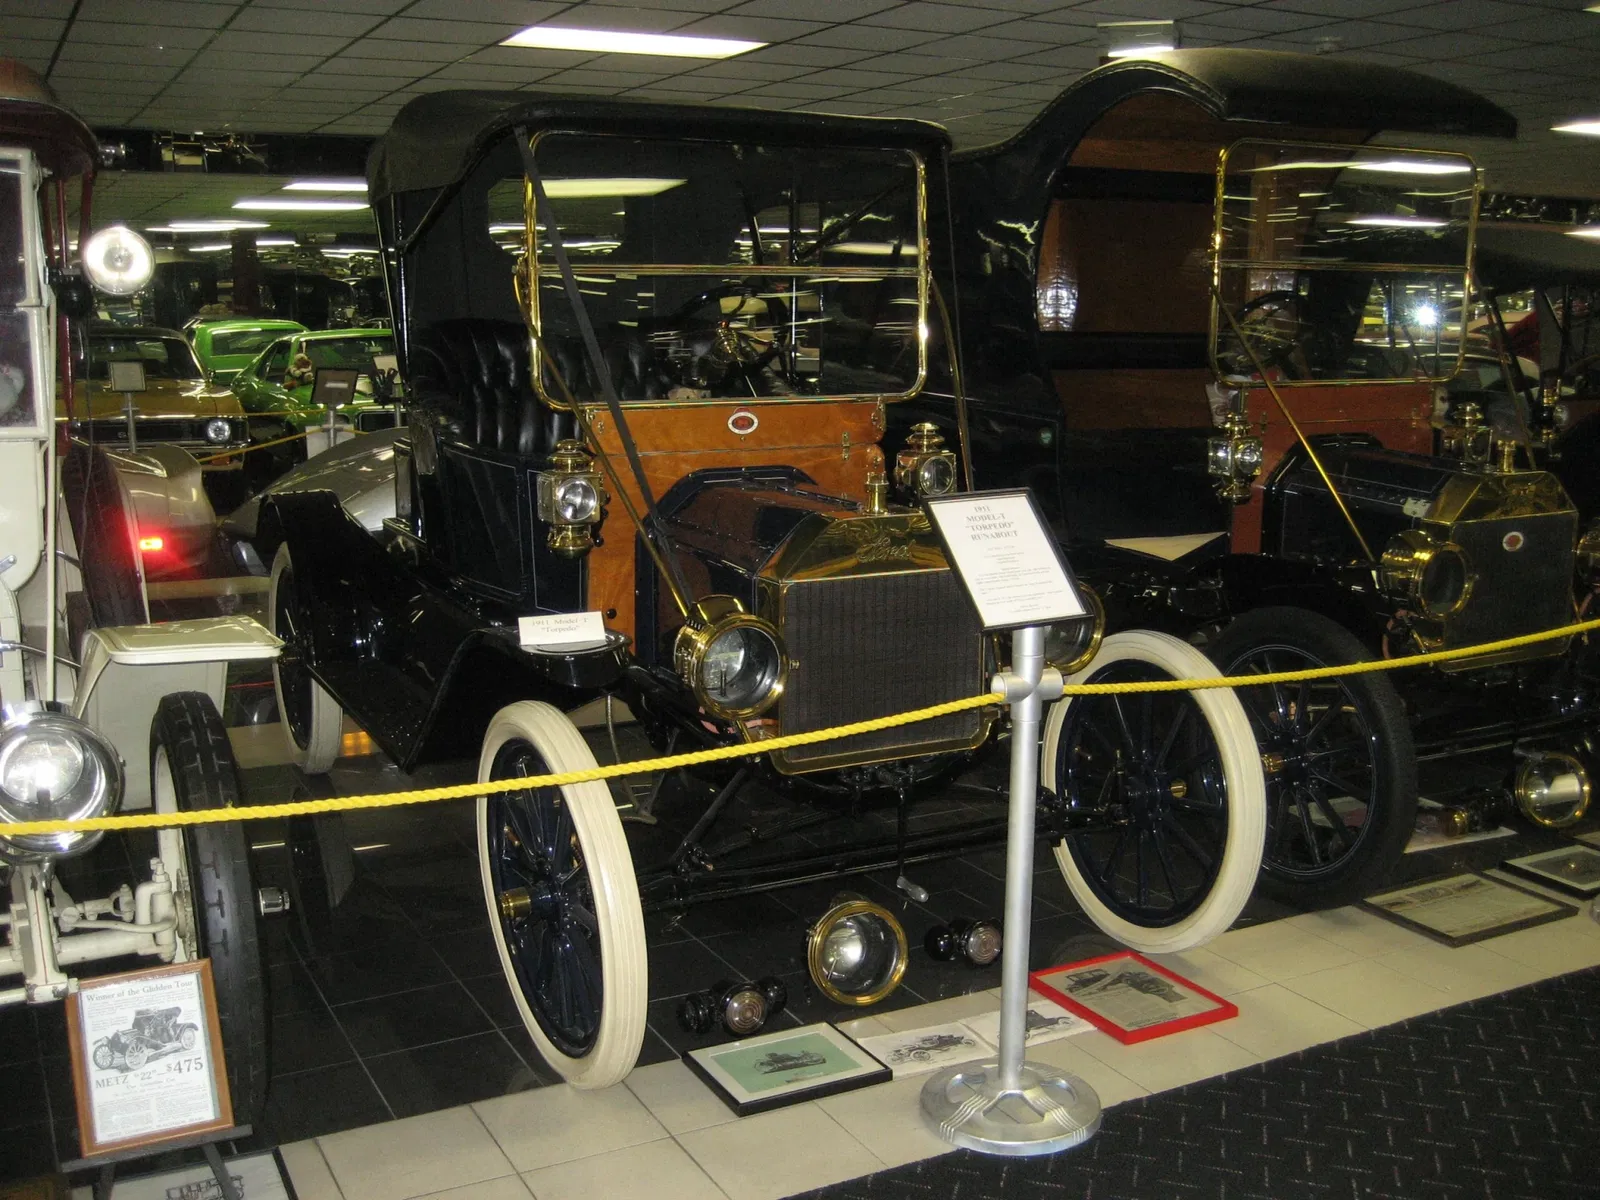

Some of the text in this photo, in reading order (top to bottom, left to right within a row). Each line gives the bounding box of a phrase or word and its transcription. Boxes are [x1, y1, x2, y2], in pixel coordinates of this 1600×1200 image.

[973, 505, 991, 513] 1911
[965, 513, 1006, 523] MODEL-T
[965, 521, 1014, 532] "TORPEDO"
[970, 530, 1018, 542] RUNABOUT
[540, 625, 581, 634] "Torpedo"
[86, 991, 116, 1002] Winner
[128, 988, 140, 996] the
[142, 983, 173, 994] Glidden
[174, 980, 193, 989] Tour
[95, 1074, 129, 1089] METZ
